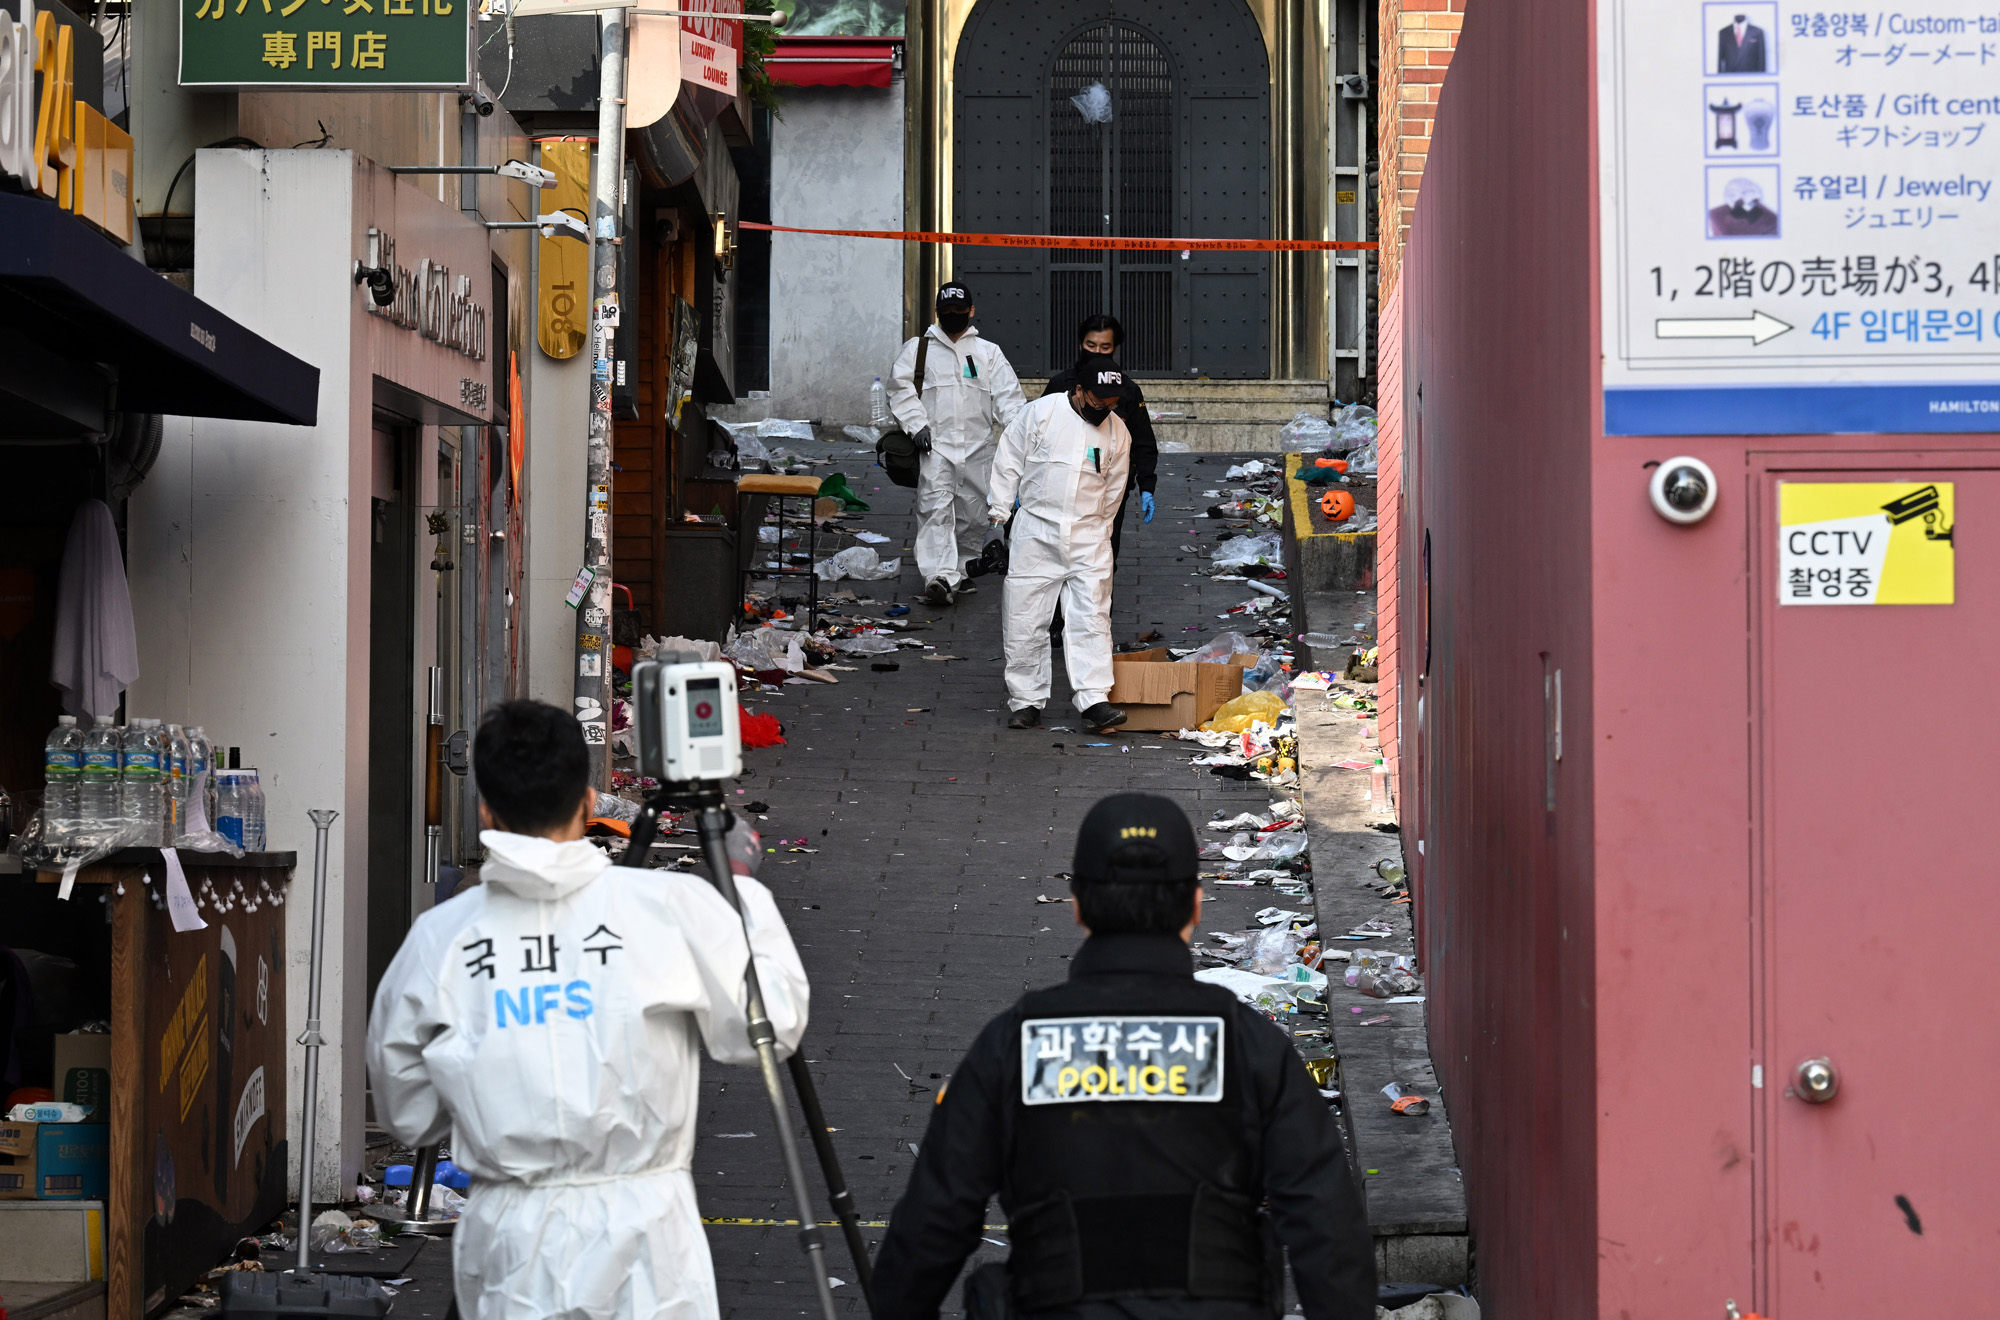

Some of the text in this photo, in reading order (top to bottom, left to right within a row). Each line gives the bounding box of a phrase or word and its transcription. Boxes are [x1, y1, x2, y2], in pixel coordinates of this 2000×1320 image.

[1791, 13, 1869, 38] 맞춤양복
[691, 40, 716, 62] LUXURY
[1835, 43, 1996, 67] オーダーメード
[703, 64, 728, 87] LOUNGE
[1792, 95, 1868, 119] 토산품
[1893, 93, 1940, 116] Gift
[1836, 124, 1986, 149] ギフトショップ
[1793, 175, 1868, 201] 쥬얼리
[1894, 174, 1992, 202] Jewelry
[1844, 207, 1959, 229] ジュエリー
[940, 287, 965, 299] NFS
[551, 280, 575, 334] 108
[1811, 312, 1852, 341] 4F
[1860, 308, 1983, 343] 임대문의
[1097, 371, 1122, 384] NFS
[1929, 400, 1999, 413] HAMILTON
[1789, 531, 1872, 555] CCTV
[1789, 568, 1871, 598] 촬영중
[463, 924, 623, 979] 국과수
[495, 979, 594, 1028] NFS
[1035, 1024, 1210, 1062] 과학수사
[1058, 1064, 1188, 1095] POLICE
